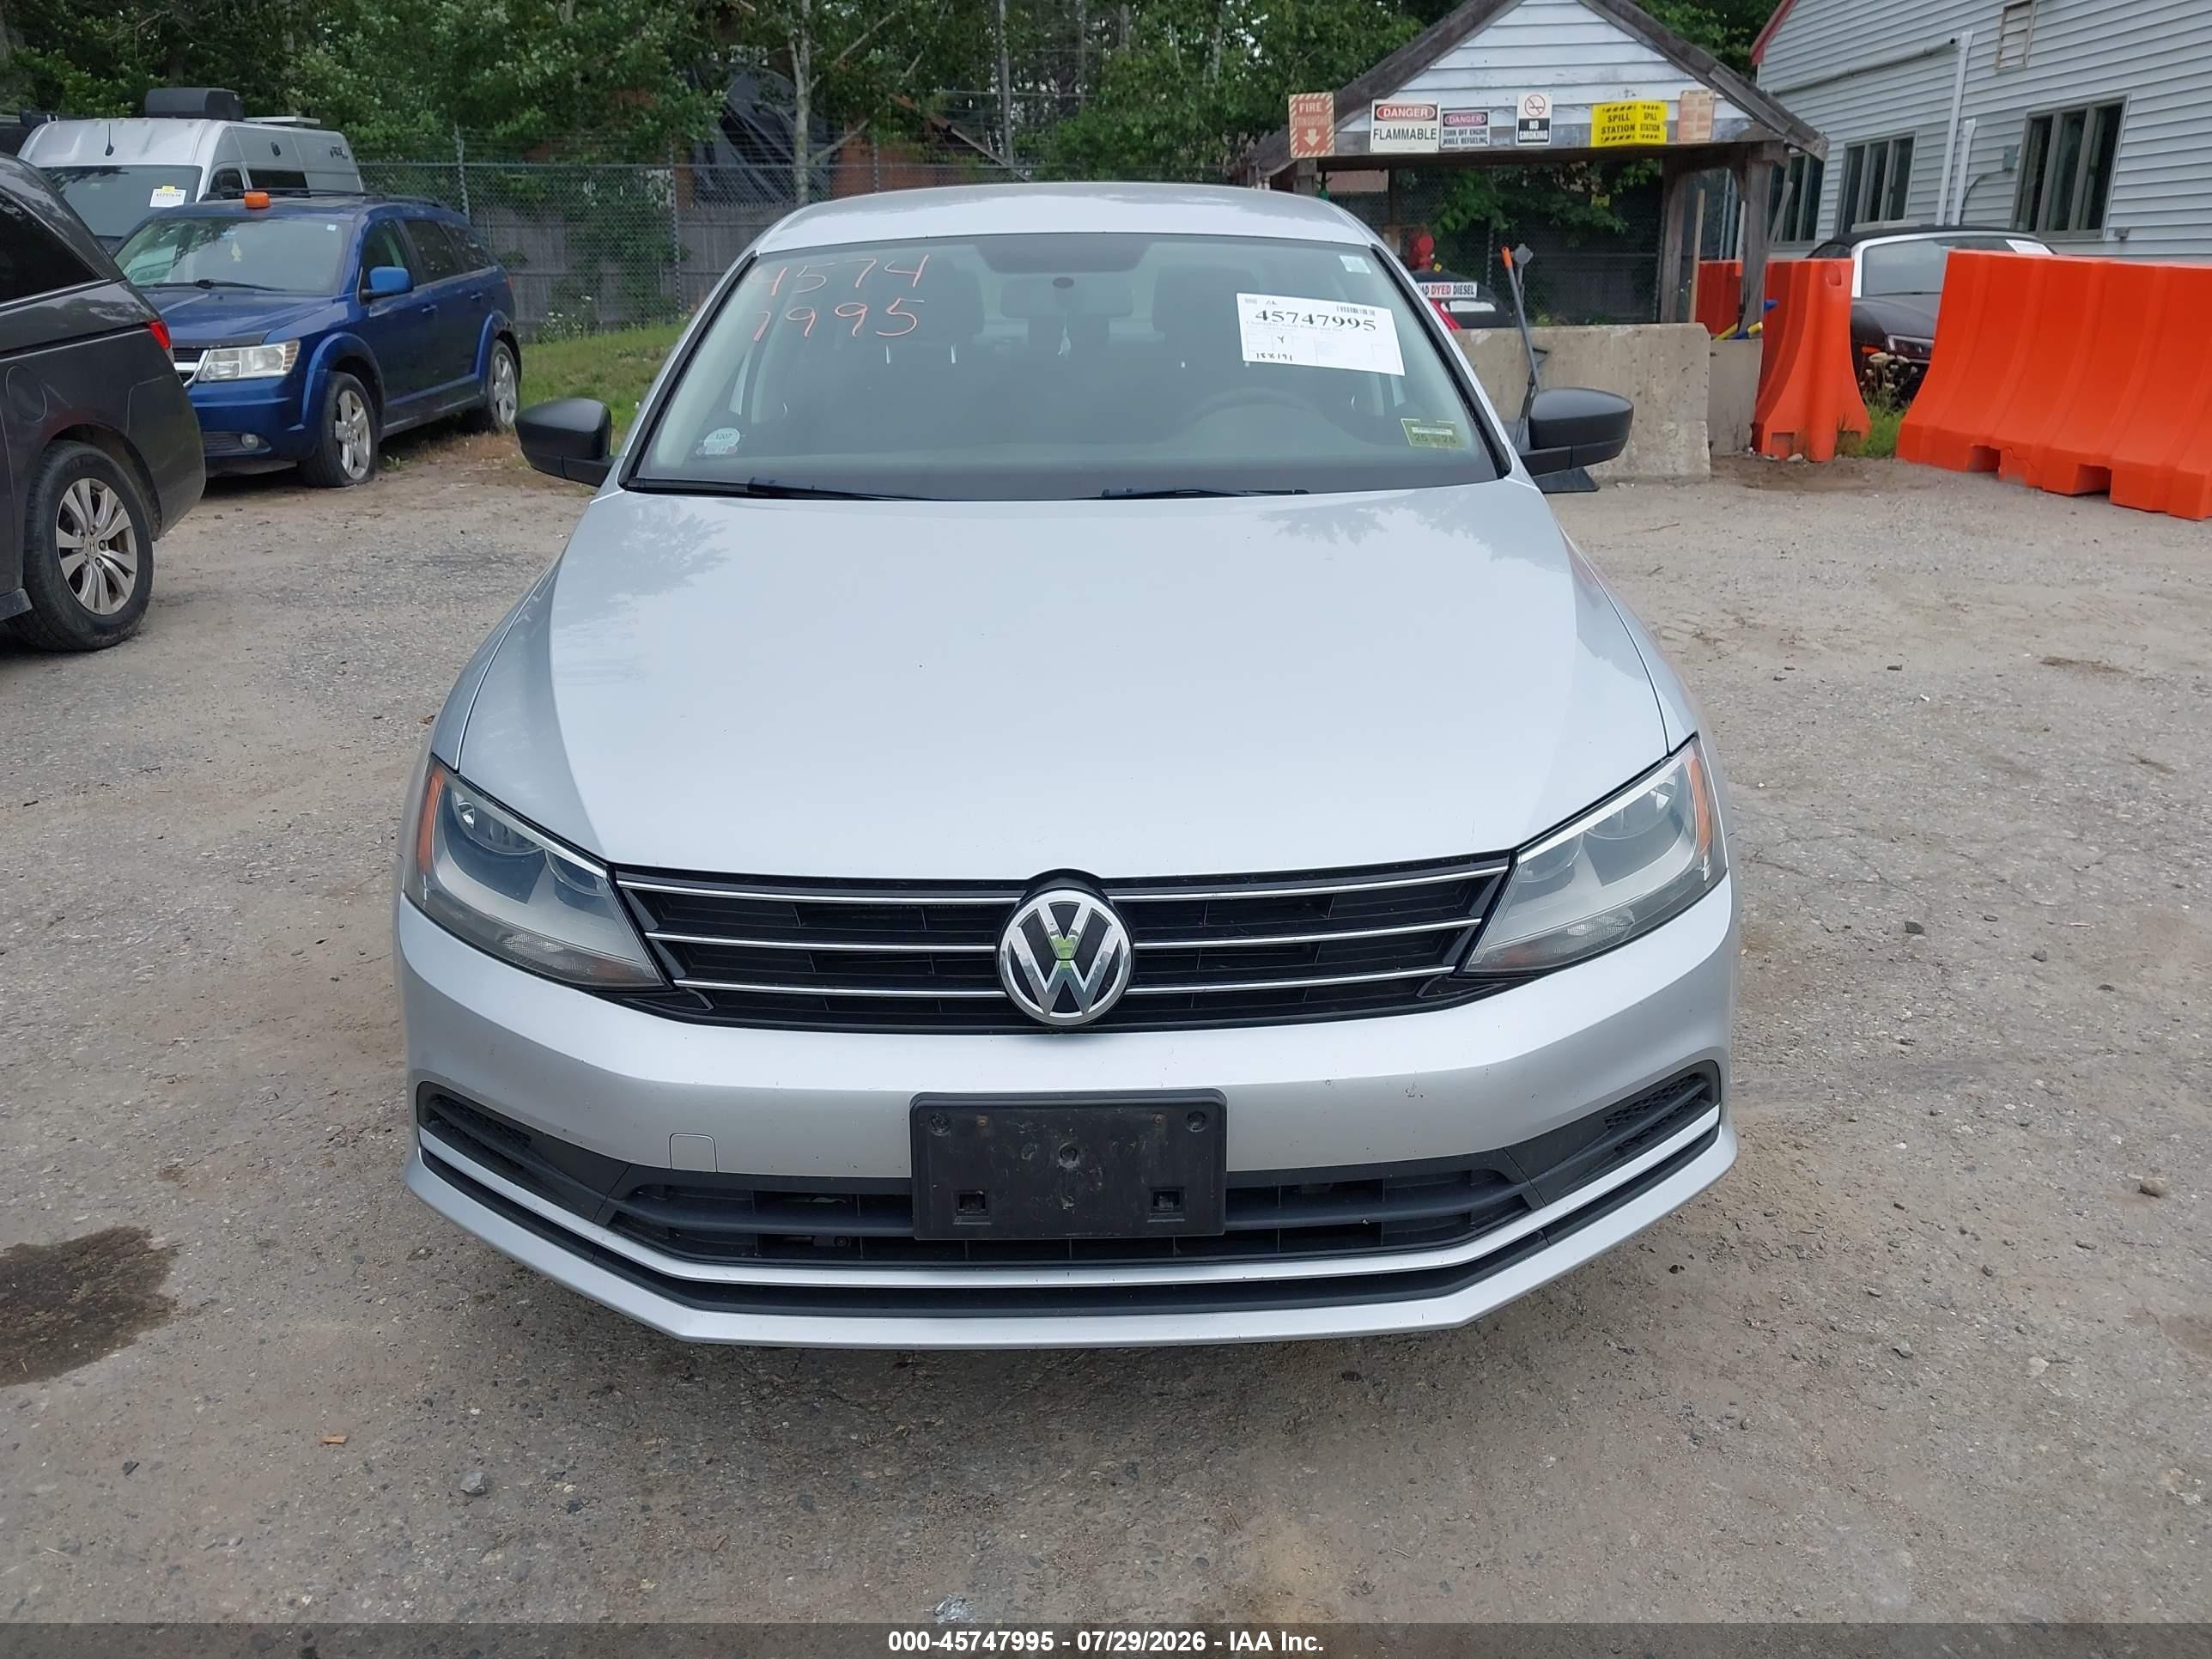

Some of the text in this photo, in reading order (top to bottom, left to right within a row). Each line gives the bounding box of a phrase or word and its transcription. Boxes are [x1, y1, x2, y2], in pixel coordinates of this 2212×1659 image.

[1298, 102, 1322, 113] FIRE
[1383, 108, 1428, 118] DANGER
[1607, 113, 1630, 123] SPILL
[1644, 112, 1657, 121] SPILL
[1449, 115, 1483, 124] DANGER
[1528, 120, 1540, 130] NO
[1601, 124, 1636, 135] STATION
[1640, 123, 1660, 132] STATION
[1373, 128, 1437, 140] FLAMMABLE
[1518, 131, 1548, 140] SMOKING
[748, 254, 929, 296] 4574
[1431, 285, 1451, 295] DYED
[1453, 285, 1474, 295] DIESEL
[754, 297, 925, 342] 7995
[1255, 309, 1376, 331] 45747995
